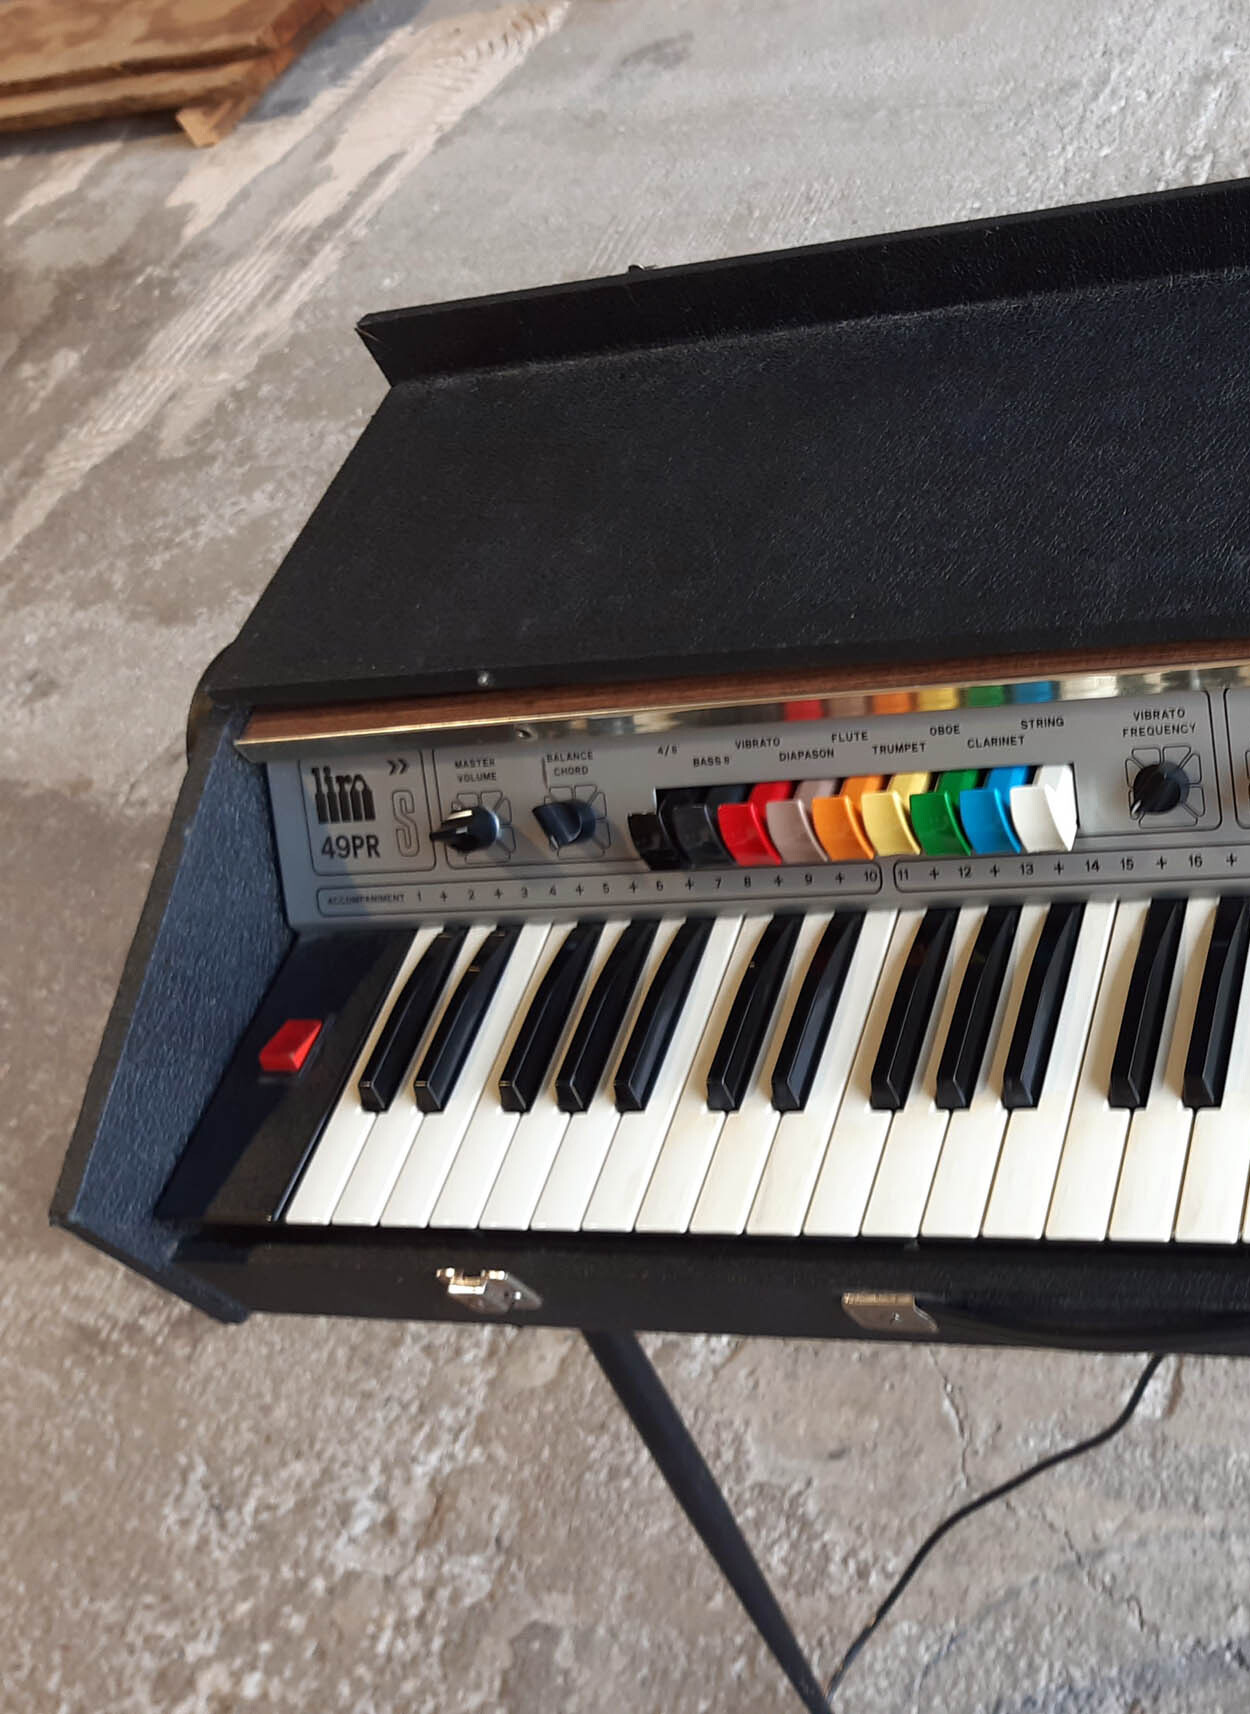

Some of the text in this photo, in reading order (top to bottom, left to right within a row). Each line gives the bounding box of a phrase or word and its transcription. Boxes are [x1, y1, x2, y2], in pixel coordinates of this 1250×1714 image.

[1133, 709, 1185, 721] VIBRATO
[1021, 717, 1064, 729] STRING
[930, 725, 960, 736] OBOE
[1123, 723, 1195, 737] FREQUENCY
[832, 731, 868, 743] FLUTE
[967, 735, 1024, 748] CLARINET
[734, 737, 781, 750] VIBRATO
[872, 743, 925, 754] TRUMPET
[546, 750, 594, 763] BALANCE
[779, 748, 834, 761] DIAPASON
[455, 758, 495, 769] MASTER
[693, 757, 721, 768] BASS
[554, 765, 588, 776] CHORD
[457, 772, 496, 783] VOLUME
[321, 834, 380, 859] 49PR
[897, 867, 909, 881] 11
[959, 866, 971, 878] 12
[1021, 862, 1033, 875] 13
[1086, 860, 1099, 872] 14
[1121, 858, 1134, 870] 15
[1189, 855, 1202, 868] 16
[864, 870, 877, 882] 10
